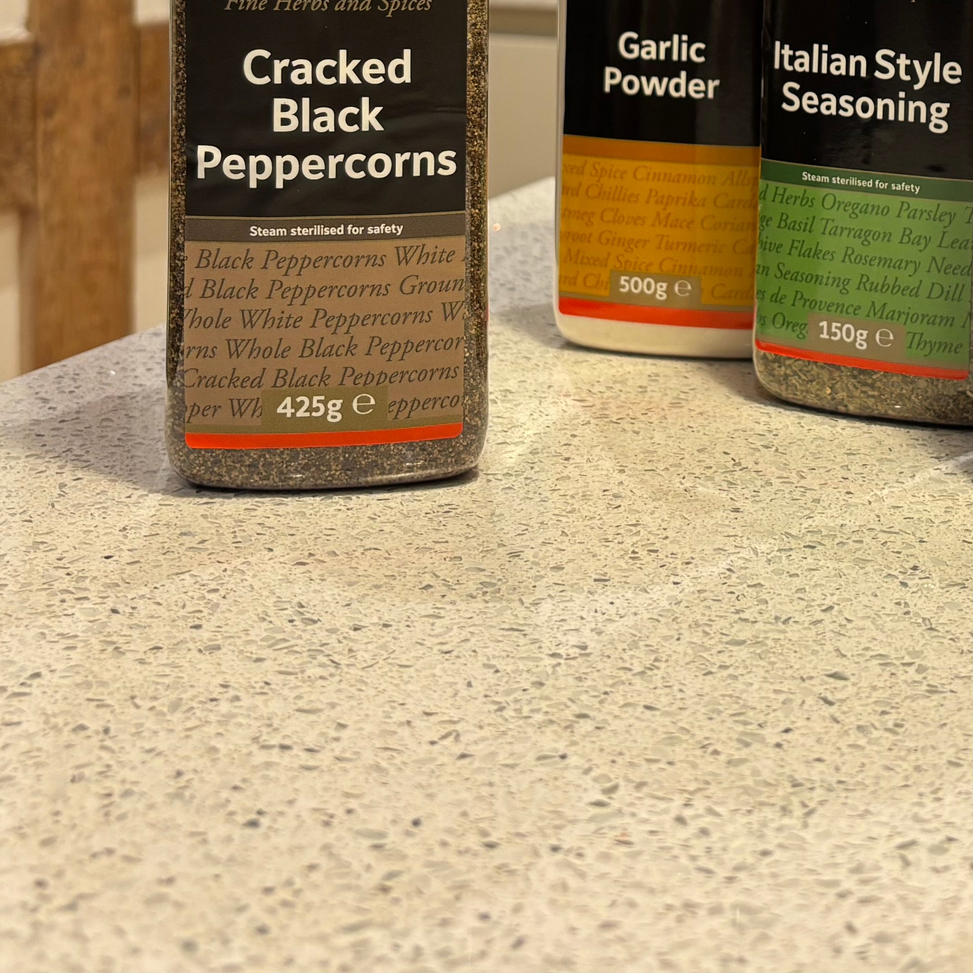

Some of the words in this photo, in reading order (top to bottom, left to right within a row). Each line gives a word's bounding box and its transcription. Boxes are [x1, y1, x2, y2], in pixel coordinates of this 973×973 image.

[618, 31, 706, 63] Garlic
[243, 48, 412, 85] Cracked
[774, 40, 867, 77] Italian
[874, 49, 962, 90] Style
[604, 66, 720, 99] Powder
[273, 97, 384, 132] Black
[782, 82, 950, 134] Seasoning
[197, 145, 457, 189] Peppercorns
[590, 163, 628, 182] Spice
[633, 165, 716, 185] Cinnamon
[586, 184, 640, 204] Chillies
[645, 189, 706, 210] Paprika
[802, 171, 829, 183] Steam
[832, 177, 873, 188] sterilised
[875, 180, 889, 190] for
[891, 182, 920, 194] safety
[600, 207, 647, 227] Cloves
[652, 211, 695, 230] Mace
[771, 187, 816, 208] Herbs
[821, 193, 890, 219] Oregano
[896, 201, 956, 228] Parsley
[250, 226, 287, 237] Steam
[290, 225, 344, 236] sterilised
[347, 224, 364, 235] for
[367, 223, 404, 236] safety
[599, 230, 649, 253] Ginger
[656, 234, 724, 254] Turmeric
[777, 212, 816, 233] Basil
[820, 217, 892, 246] Tarragon
[898, 228, 932, 252] Bay
[195, 248, 253, 270] Black
[261, 249, 387, 276] Peppercorns
[394, 244, 456, 266] White
[563, 248, 610, 269] Mixed
[614, 254, 651, 271] Spice
[659, 257, 744, 276] Cinnamon
[787, 239, 836, 261] Flakes
[842, 247, 921, 277] Rosemary
[200, 279, 259, 299] Black
[266, 279, 391, 306] Peppercorns
[620, 276, 668, 300] 500g
[775, 262, 852, 294] Seasoning
[856, 274, 920, 299] Rubbed
[926, 282, 966, 302] Dill
[184, 308, 232, 329] hole
[240, 308, 303, 329] White
[310, 308, 433, 335] Peppercorns
[770, 287, 787, 304] de
[791, 290, 861, 316] Provence
[866, 301, 955, 327] Marjoram
[226, 338, 291, 359] Whole
[298, 334, 358, 358] Black
[819, 320, 868, 350] 150g
[906, 331, 963, 357] Thyme
[184, 368, 264, 389] Cracked
[272, 366, 331, 388] Black
[338, 364, 459, 387] Peppercorns
[277, 395, 344, 423] 425g
